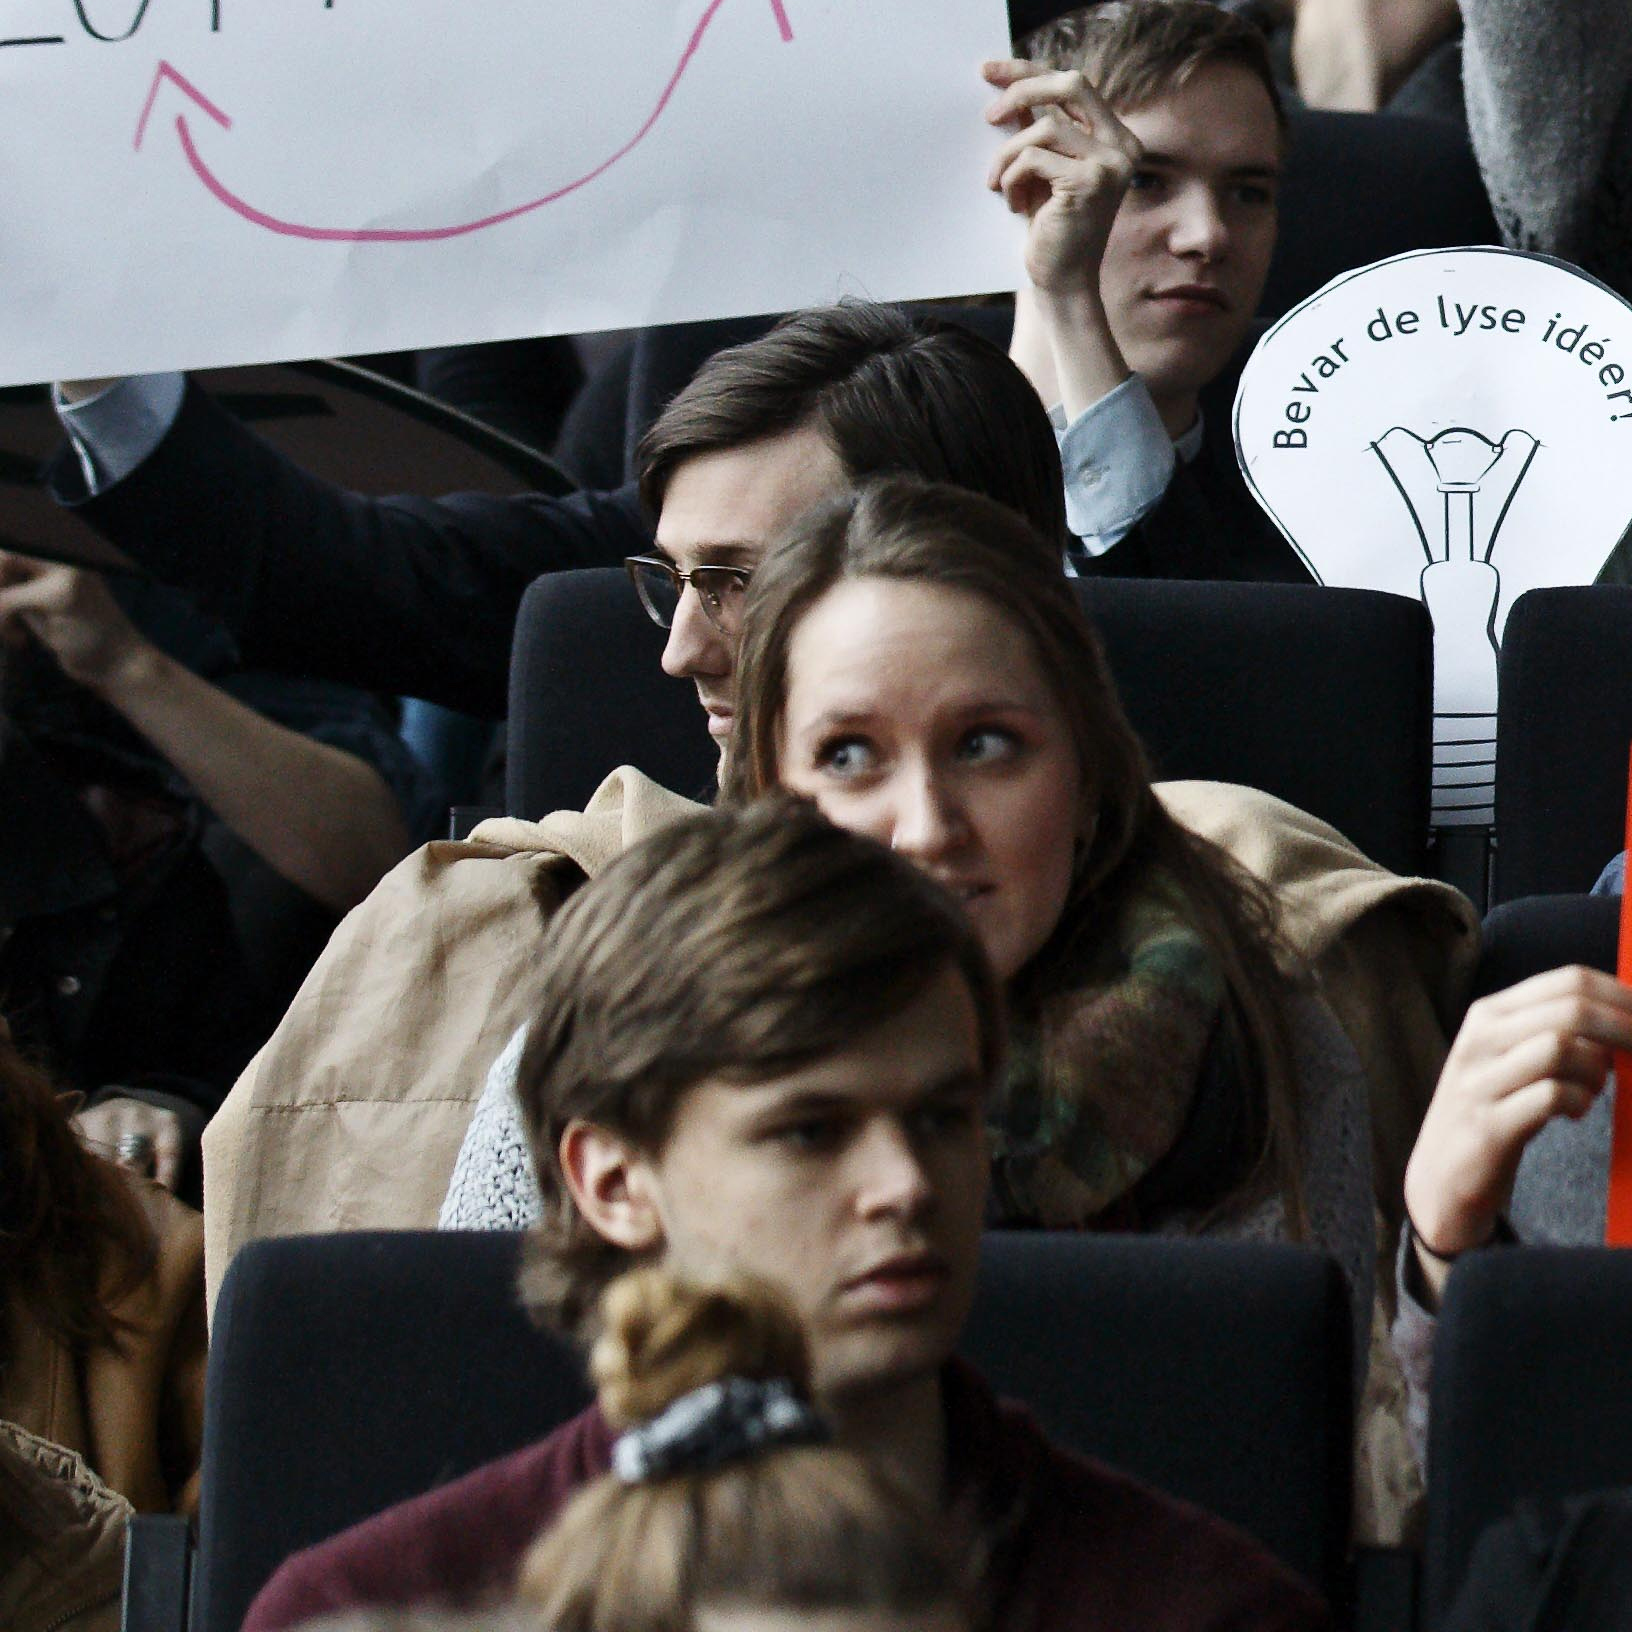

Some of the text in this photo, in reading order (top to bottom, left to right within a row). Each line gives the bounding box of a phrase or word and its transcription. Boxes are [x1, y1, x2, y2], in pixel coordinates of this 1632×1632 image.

[1272, 337, 1350, 449] Bevar
[1367, 307, 1420, 343] de
[1437, 294, 1526, 337] lyse
